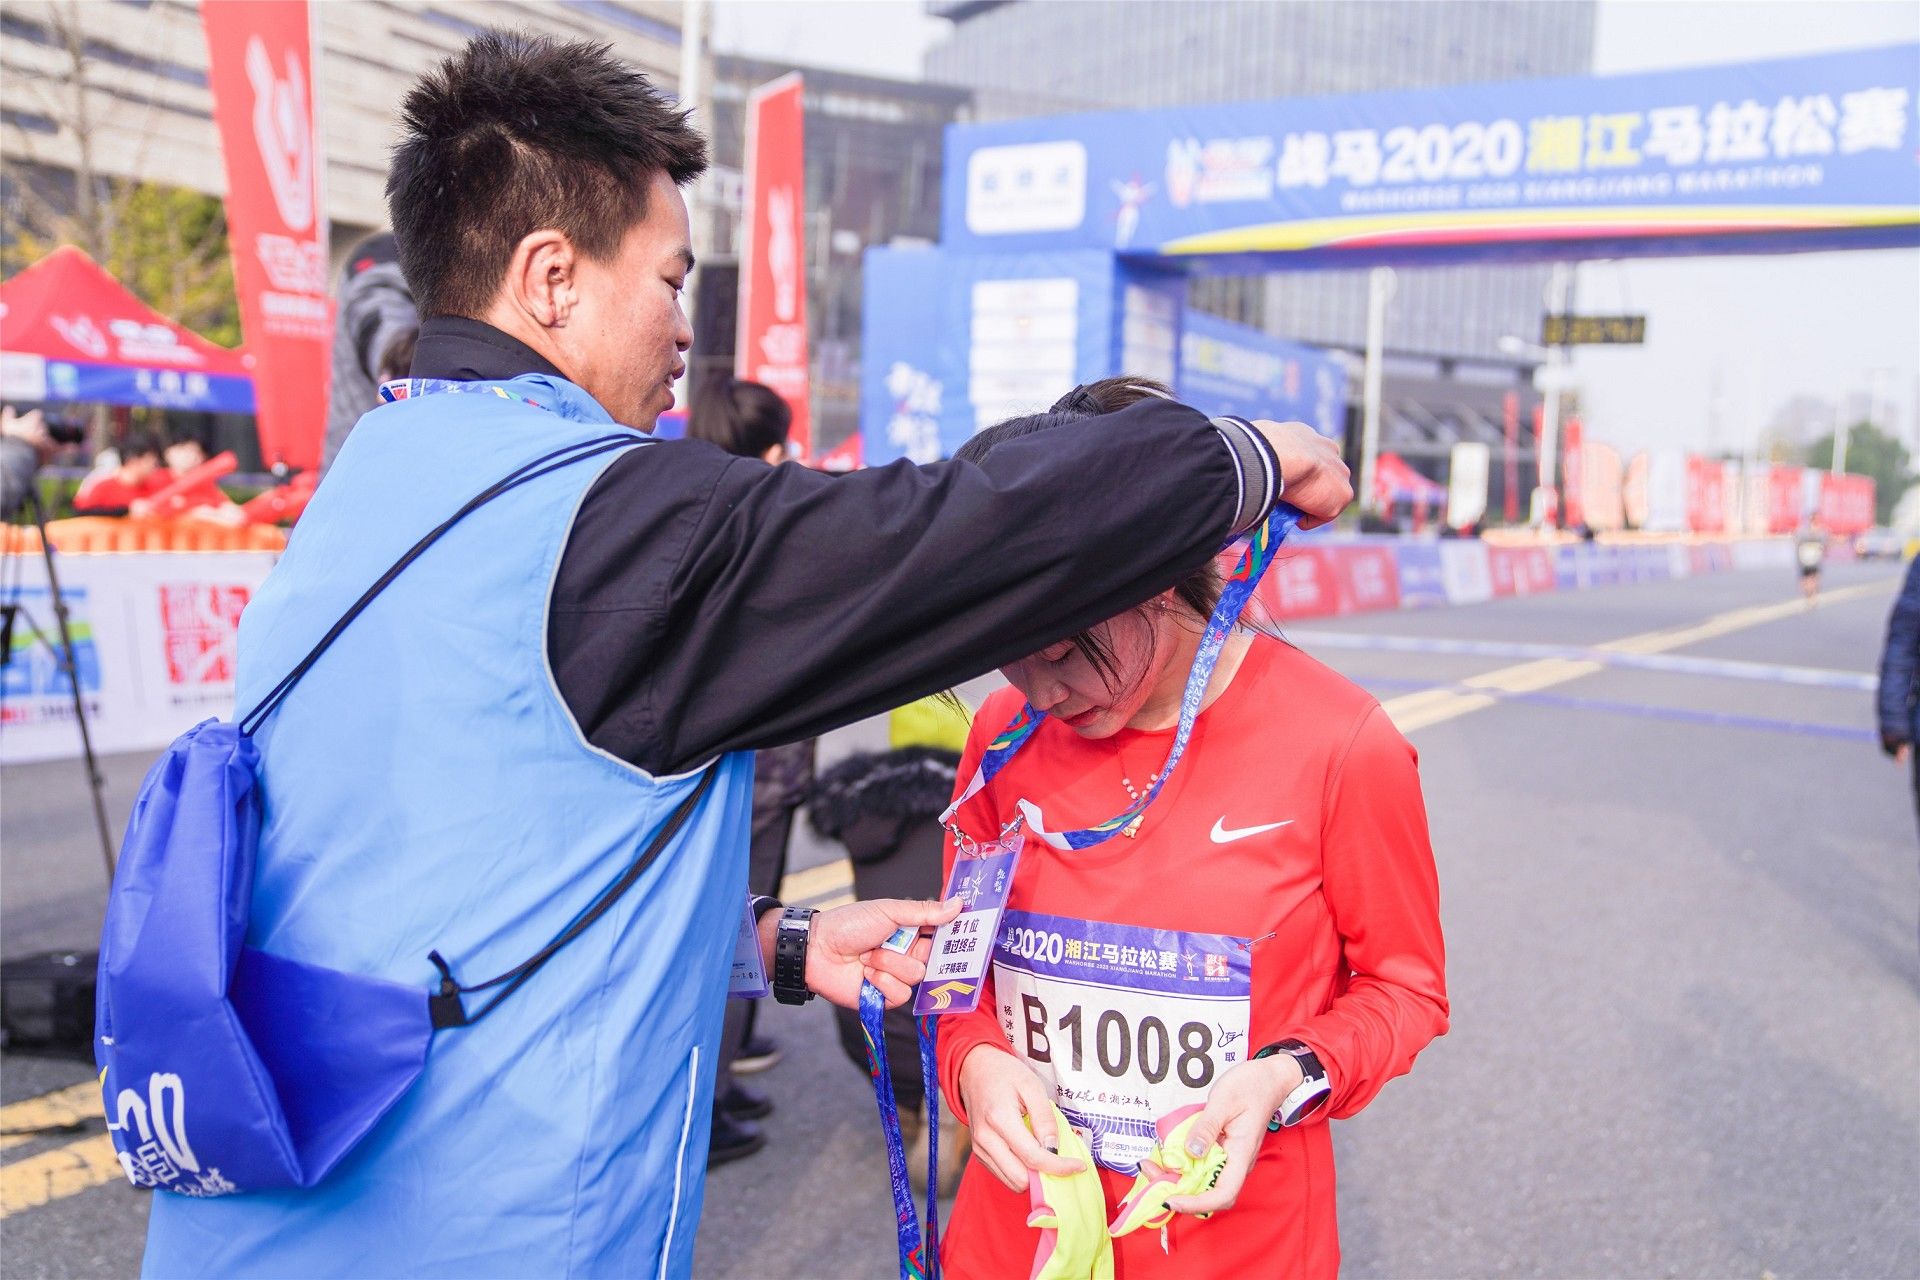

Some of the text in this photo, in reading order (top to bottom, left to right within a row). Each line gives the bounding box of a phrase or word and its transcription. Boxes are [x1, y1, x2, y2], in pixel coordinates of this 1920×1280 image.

[942, 938, 977, 954] 通过终点
[1064, 959, 1095, 969] WARHORSE
[1110, 965, 1143, 976] XIANGJIANG
[1145, 970, 1177, 979] MARATHON
[1021, 992, 1215, 1089] B1008
[1225, 1051, 1236, 1063] 取
